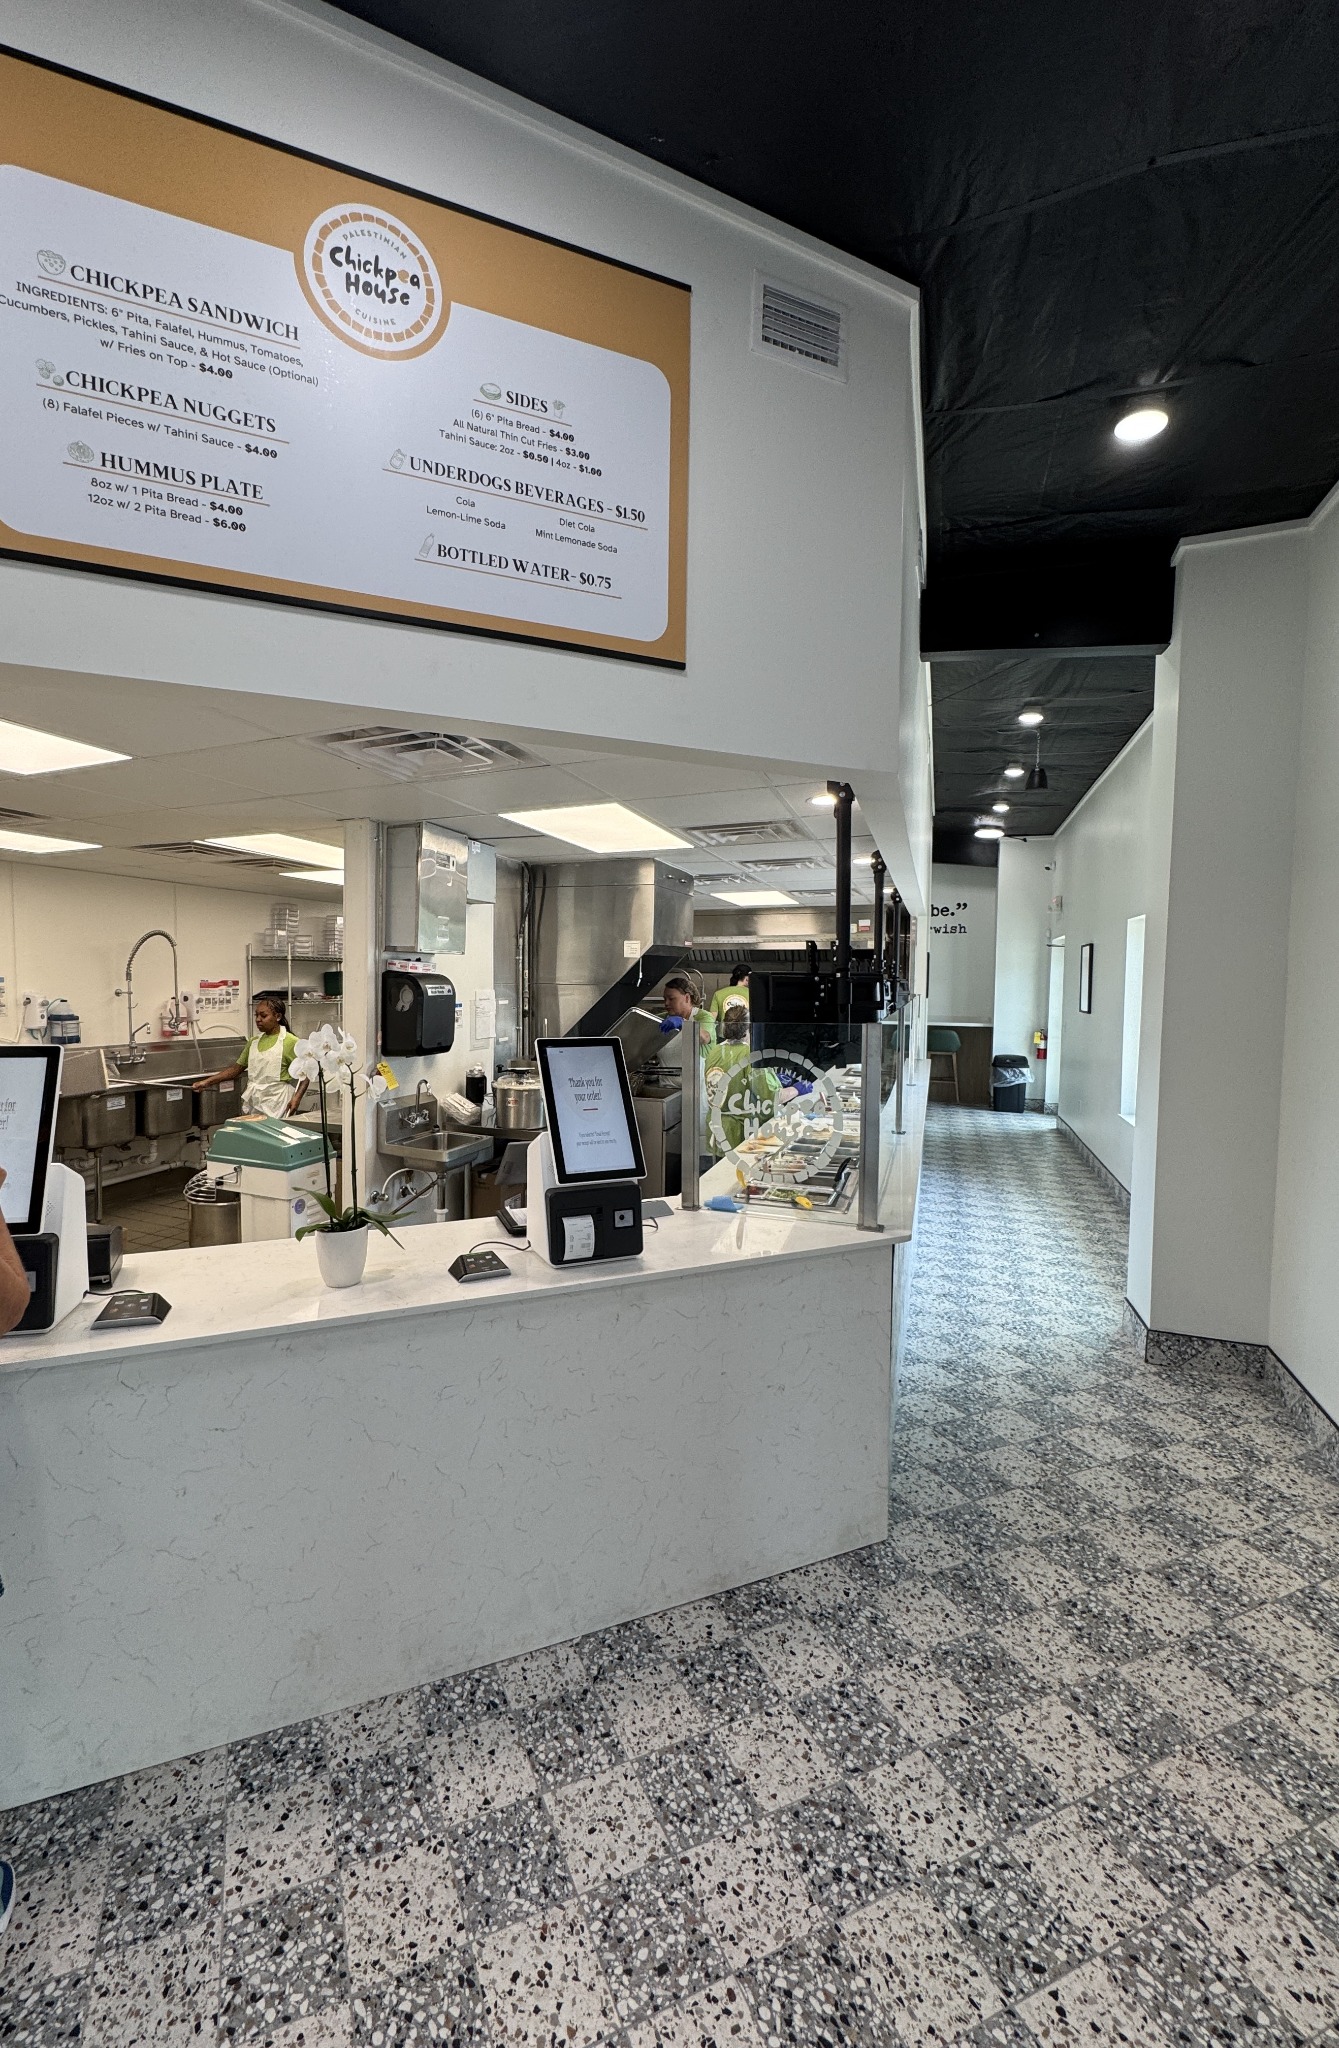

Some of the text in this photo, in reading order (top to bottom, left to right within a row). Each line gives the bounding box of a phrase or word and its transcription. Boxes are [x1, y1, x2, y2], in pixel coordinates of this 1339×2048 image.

[342, 229, 407, 260] PALESTINIAN
[329, 245, 420, 289] Chickpea
[70, 265, 299, 341] CHICKPEA SANDWICH
[345, 272, 410, 305] House
[16, 281, 108, 315] INGREDIENTS:
[126, 311, 152, 328] Pita,
[155, 319, 195, 338] Falafel,
[198, 330, 248, 353] Hummus,
[250, 344, 304, 368] Tomatoes,
[355, 308, 397, 326] CUISINE
[73, 313, 118, 336] Pickles,
[121, 326, 157, 344] Tahini
[160, 336, 197, 356] Sauce,
[199, 347, 209, 358] &
[212, 351, 231, 364] Hot
[234, 355, 266, 372] Sauce
[268, 365, 319, 388] (Optional)
[100, 339, 114, 349] w/
[118, 341, 146, 358] Fries
[149, 351, 163, 362] on
[167, 354, 188, 369] Top
[199, 361, 233, 379] $4.00
[65, 370, 276, 433] CHICKPEA NUGGETS
[506, 390, 548, 413] SIDES
[42, 397, 60, 411] (8)
[63, 402, 103, 420] Falafel
[106, 412, 144, 429] Pieces
[147, 423, 161, 432] w/
[164, 424, 198, 441] Tahini
[201, 433, 234, 449] Sauce
[244, 443, 278, 459] $4.00
[453, 418, 465, 429] All
[466, 421, 498, 437] Natural
[500, 430, 519, 442] Thin
[520, 436, 535, 447] Cut
[537, 440, 558, 452] Fries
[565, 447, 590, 461] $3.00
[471, 408, 484, 421] (6)
[497, 415, 514, 427] Pita
[516, 420, 540, 434] Bread
[549, 429, 575, 443] $4.00
[439, 428, 467, 443] Tahini
[469, 437, 497, 451] Sauce:
[499, 444, 515, 455] 2oz
[523, 450, 549, 463] $0.50
[556, 458, 571, 470] 4oz
[579, 464, 602, 477] $1.00
[100, 452, 263, 500] HUMMUS PLATE
[410, 456, 511, 492] UNDERDOGS
[515, 481, 604, 514] BEVERAGES
[615, 505, 645, 523] $1.50
[87, 493, 114, 507] 12oz
[117, 500, 131, 510] w/
[134, 502, 141, 512] 2
[145, 504, 167, 517] Pita
[170, 509, 202, 524] Bread
[213, 517, 247, 532] $6.00
[90, 477, 112, 490] 8oz
[115, 483, 129, 493] w/
[132, 486, 138, 495] 1
[141, 487, 163, 500] Pita
[166, 492, 199, 507] Bread
[209, 501, 243, 516] $4.00
[456, 496, 476, 508] Cola
[426, 505, 506, 530] Lemon-Lime Soda
[559, 517, 596, 533] Diet Cola
[535, 528, 618, 554] Mint Lemonade Soda
[437, 543, 508, 570] BOTTLED
[579, 571, 612, 590] $0.75
[930, 923, 967, 934] wish
[568, 1076, 586, 1088] Thank
[728, 1089, 826, 1125] Chicpea
